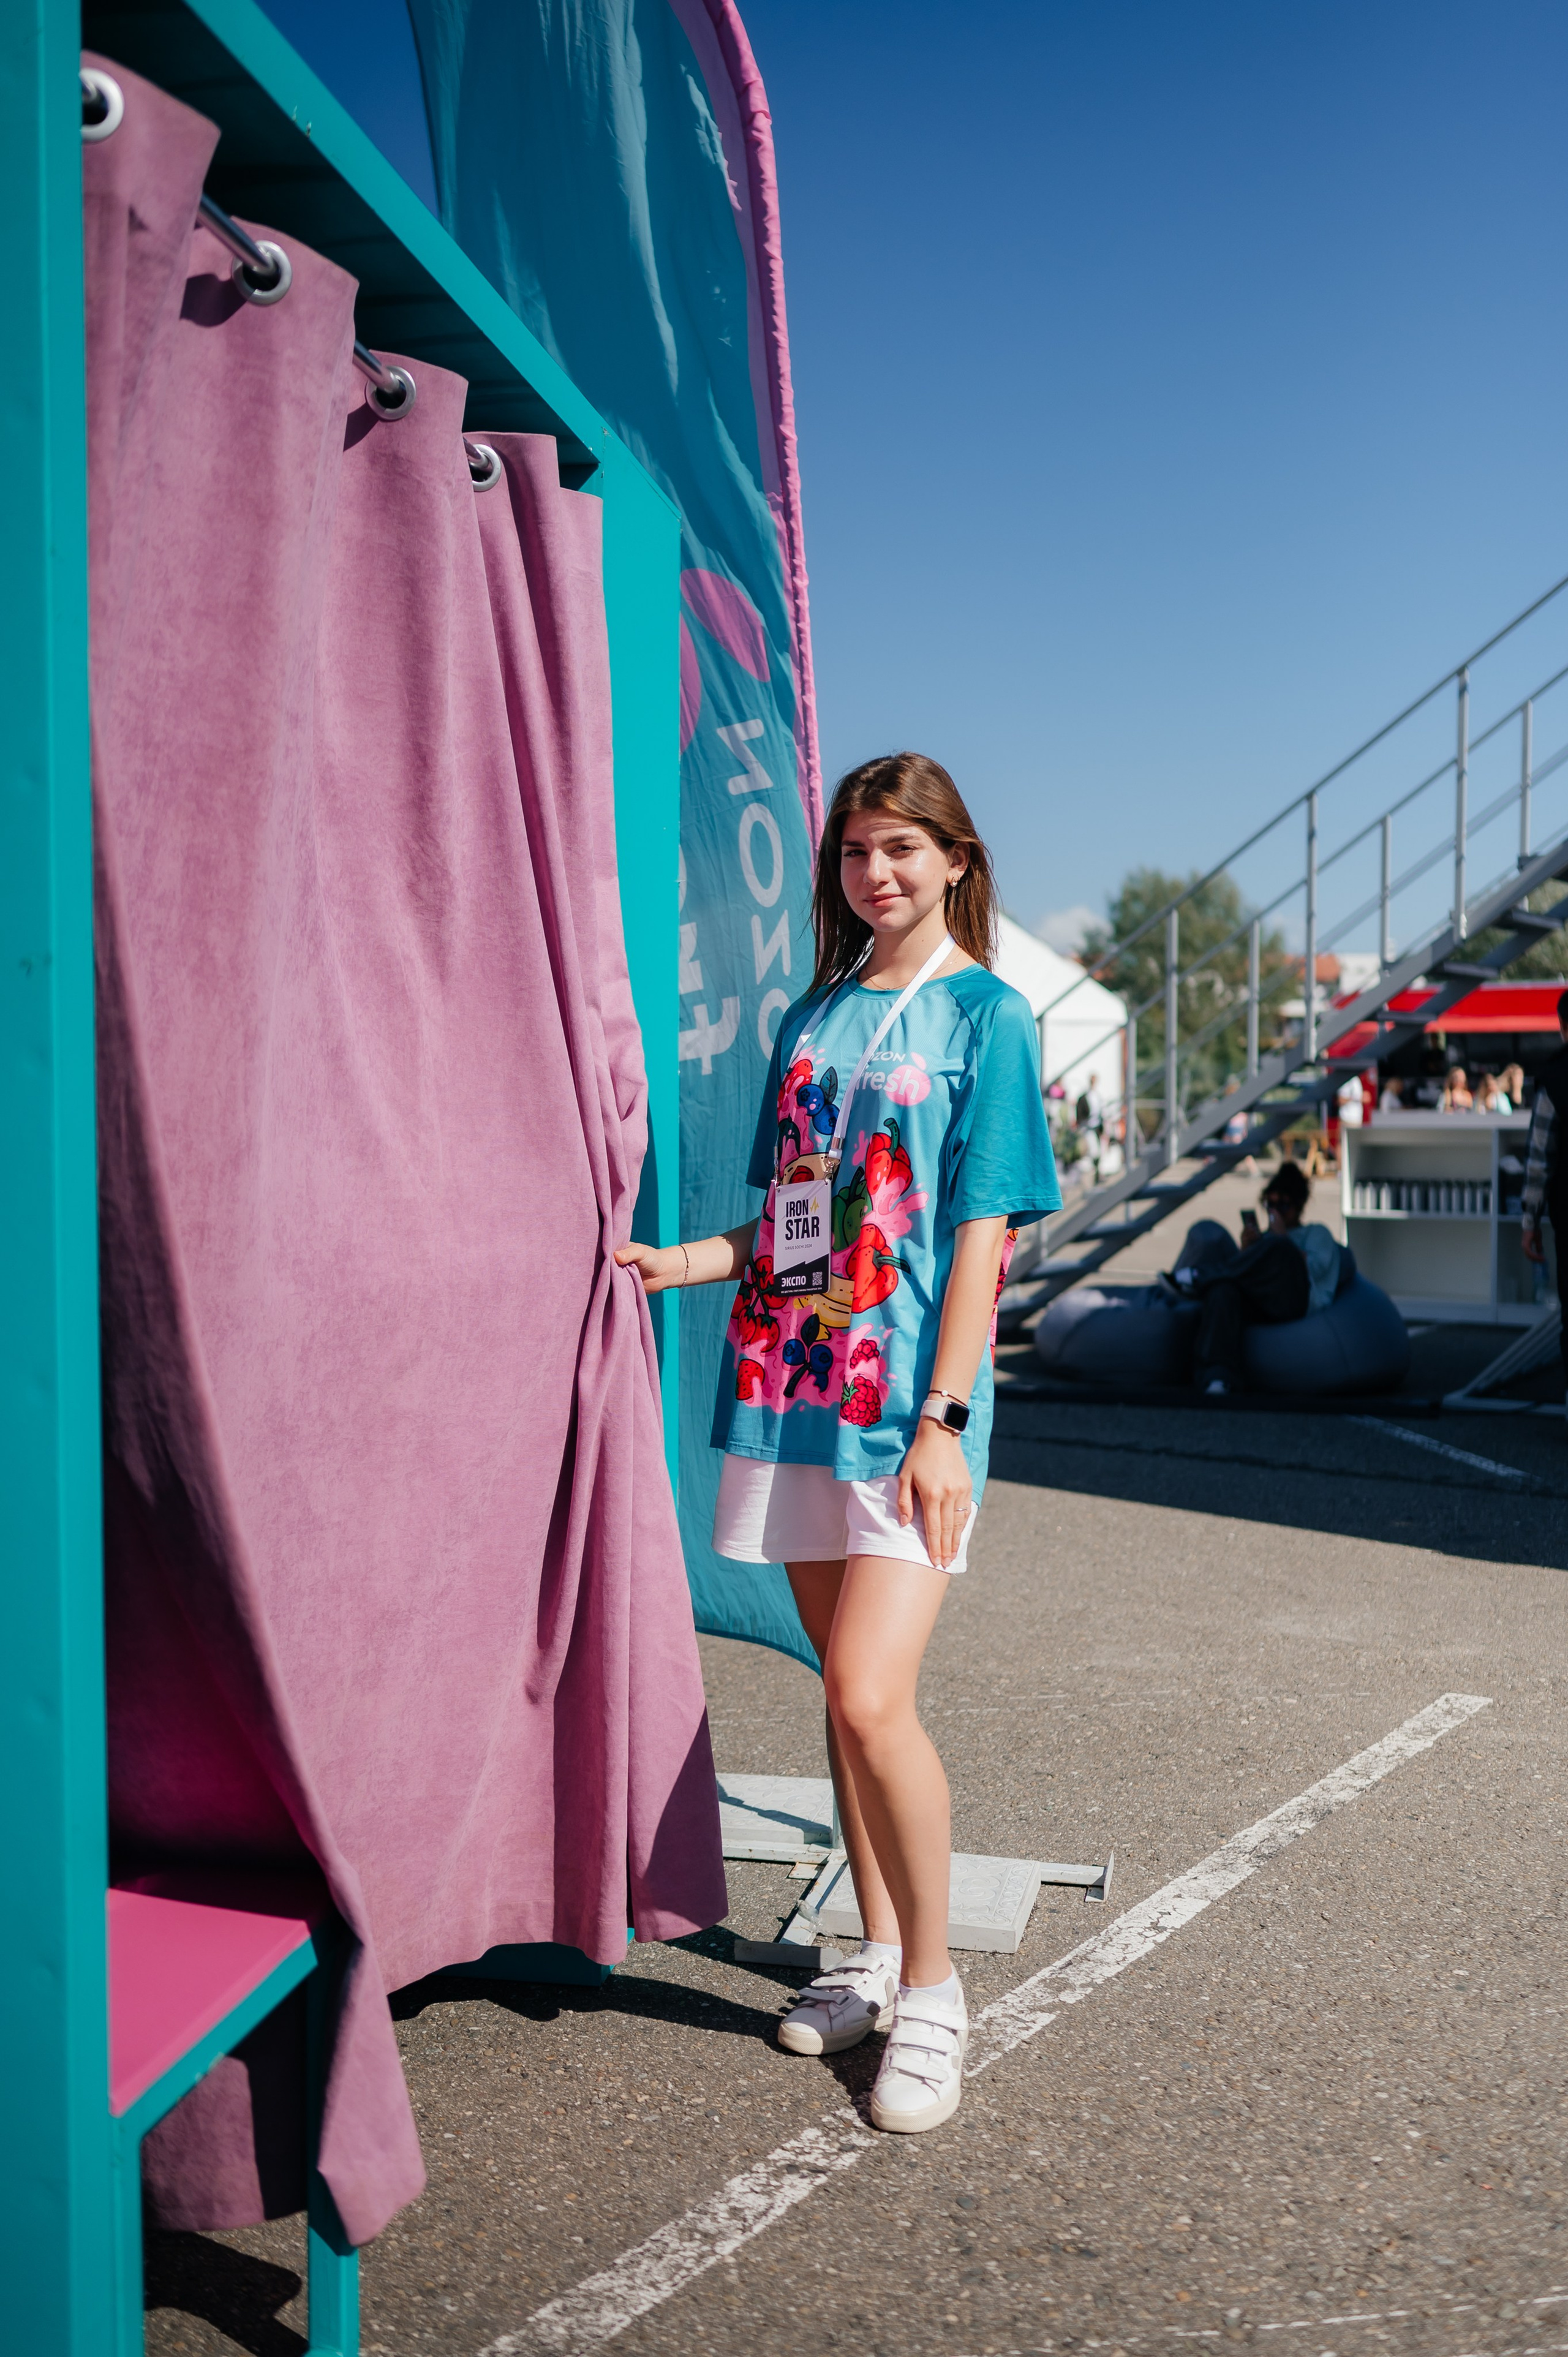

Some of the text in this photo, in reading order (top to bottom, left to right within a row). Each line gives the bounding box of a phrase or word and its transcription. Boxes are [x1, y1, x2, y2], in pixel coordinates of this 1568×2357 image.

[870, 1050, 906, 1063] ZON
[786, 1199, 809, 1218] IRON
[785, 1216, 820, 1240] STAR
[781, 1275, 807, 1287] ЭКСПО
